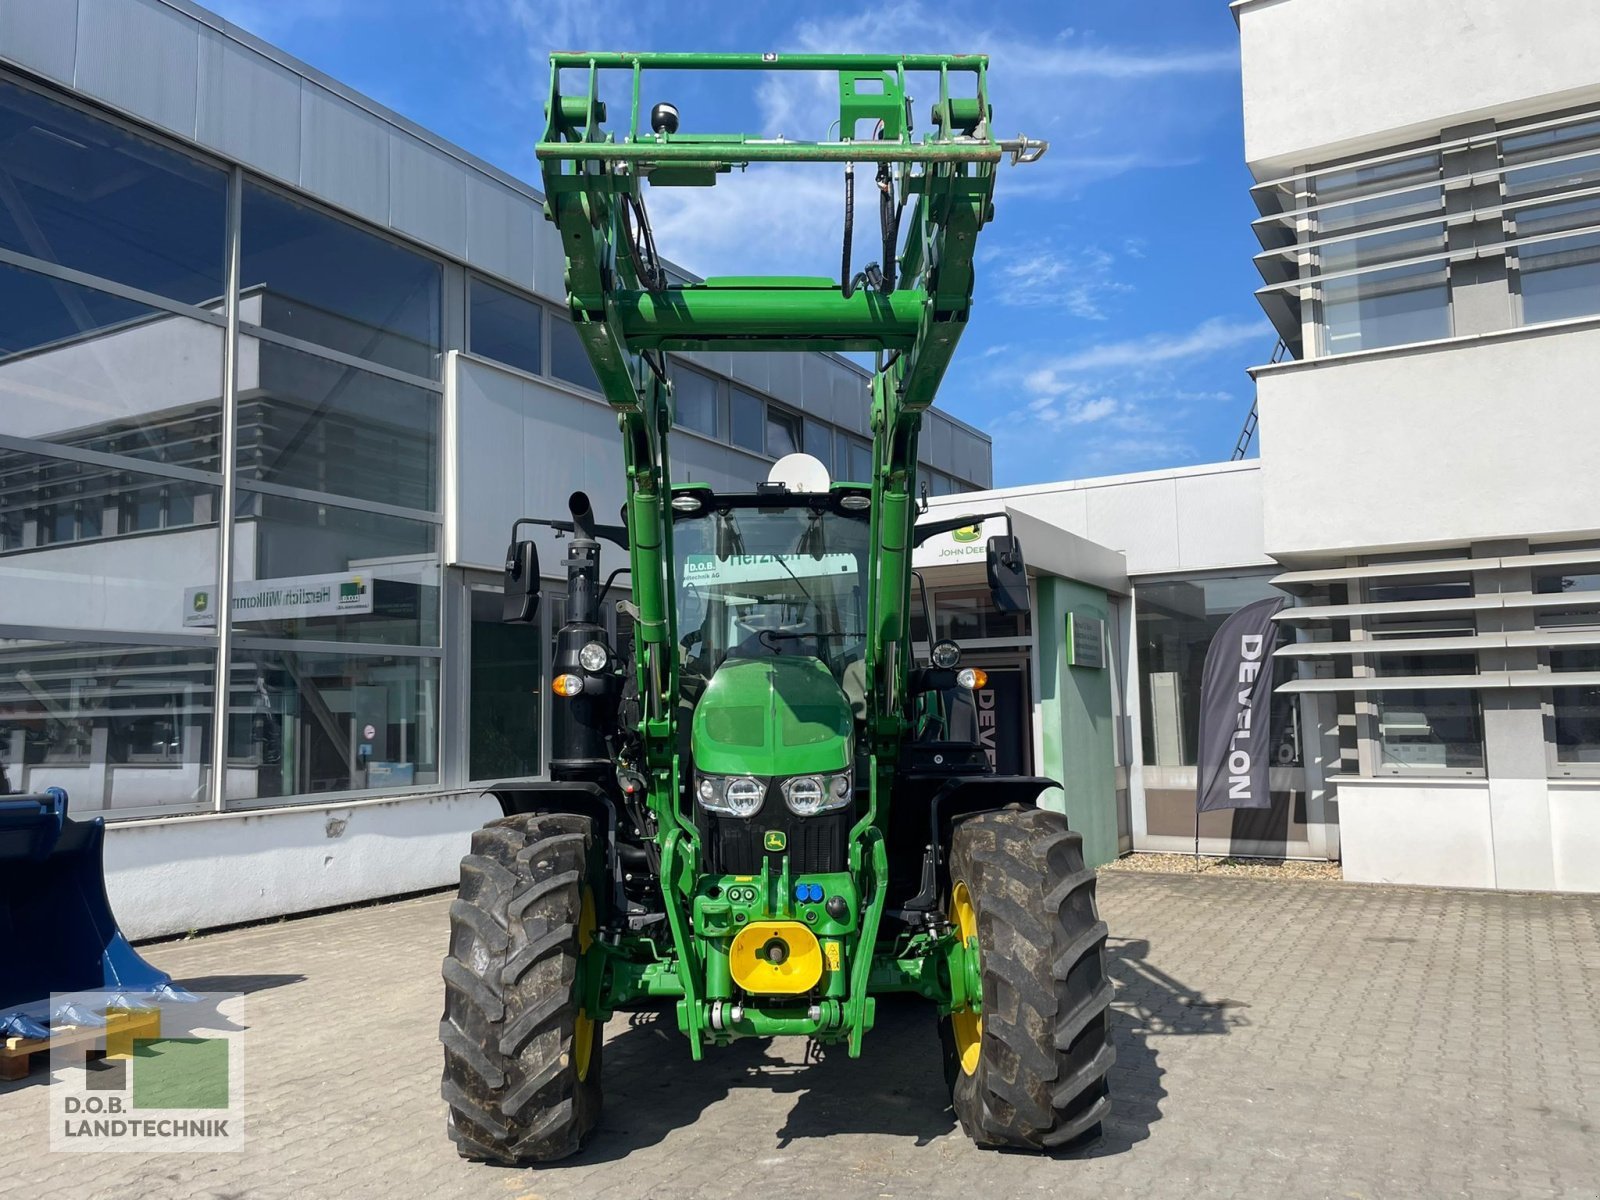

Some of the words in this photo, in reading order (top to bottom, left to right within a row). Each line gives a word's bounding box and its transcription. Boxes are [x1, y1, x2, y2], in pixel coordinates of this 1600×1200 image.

[939, 548, 964, 557] JOHN
[966, 546, 987, 554] DEE
[689, 561, 716, 572] D.O.B.
[978, 689, 997, 774] DEVE
